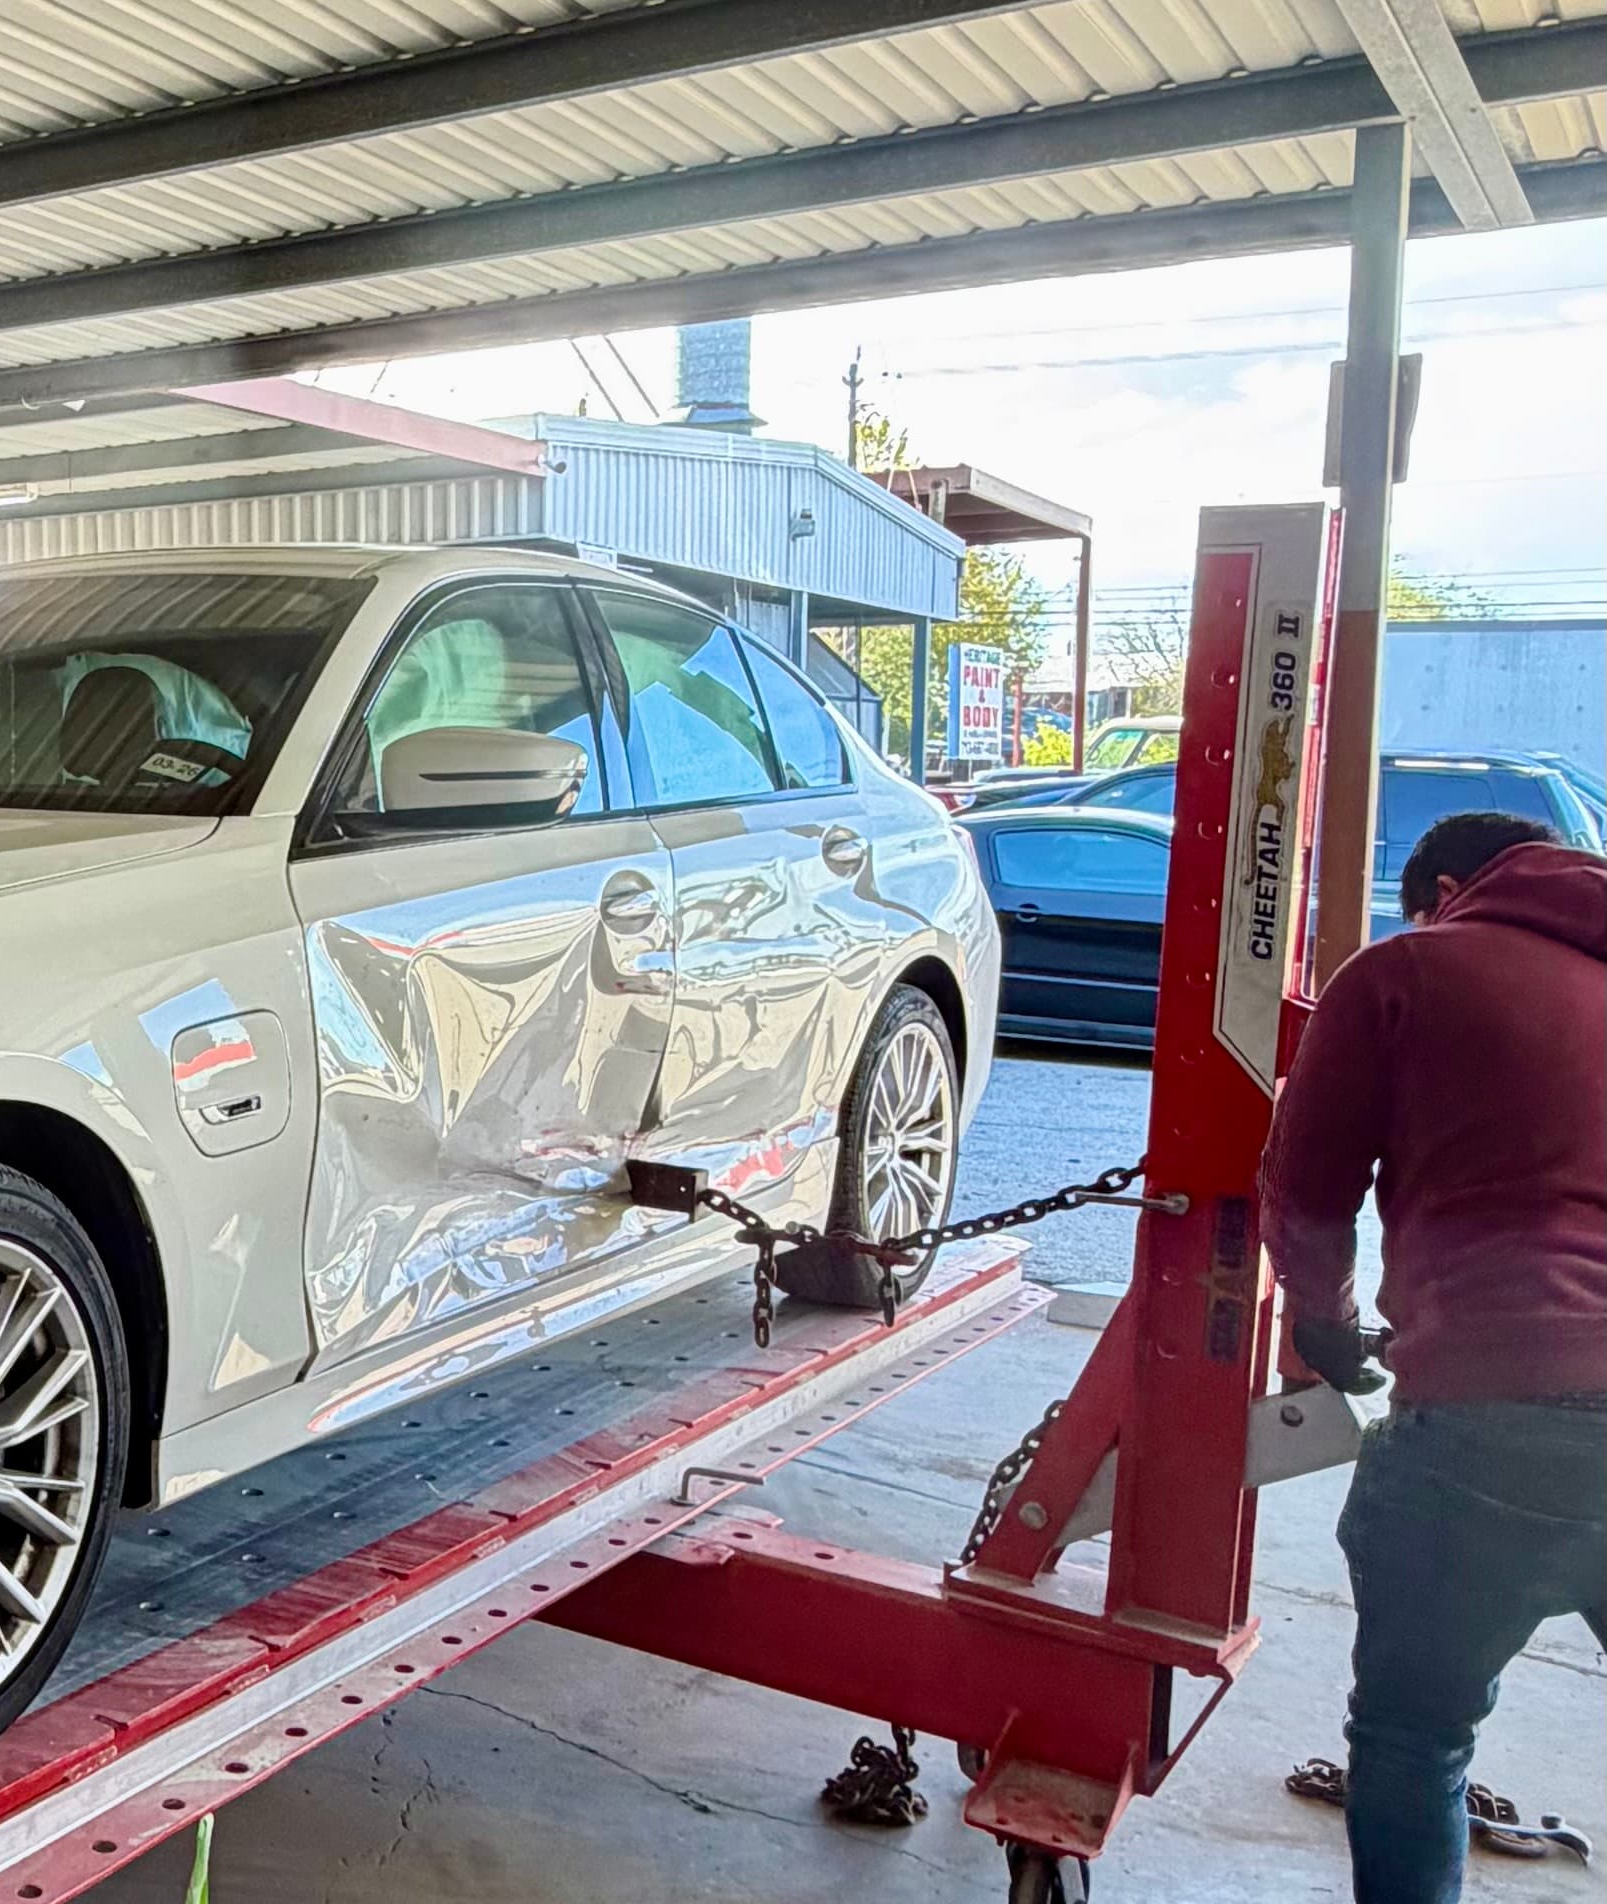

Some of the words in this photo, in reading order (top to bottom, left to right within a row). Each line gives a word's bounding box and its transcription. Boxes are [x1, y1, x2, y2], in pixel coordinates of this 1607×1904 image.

[963, 664, 1001, 689] PAINT
[963, 705, 999, 728] BODY
[1250, 822, 1282, 961] CHEETAH
[1270, 651, 1296, 711] 360
